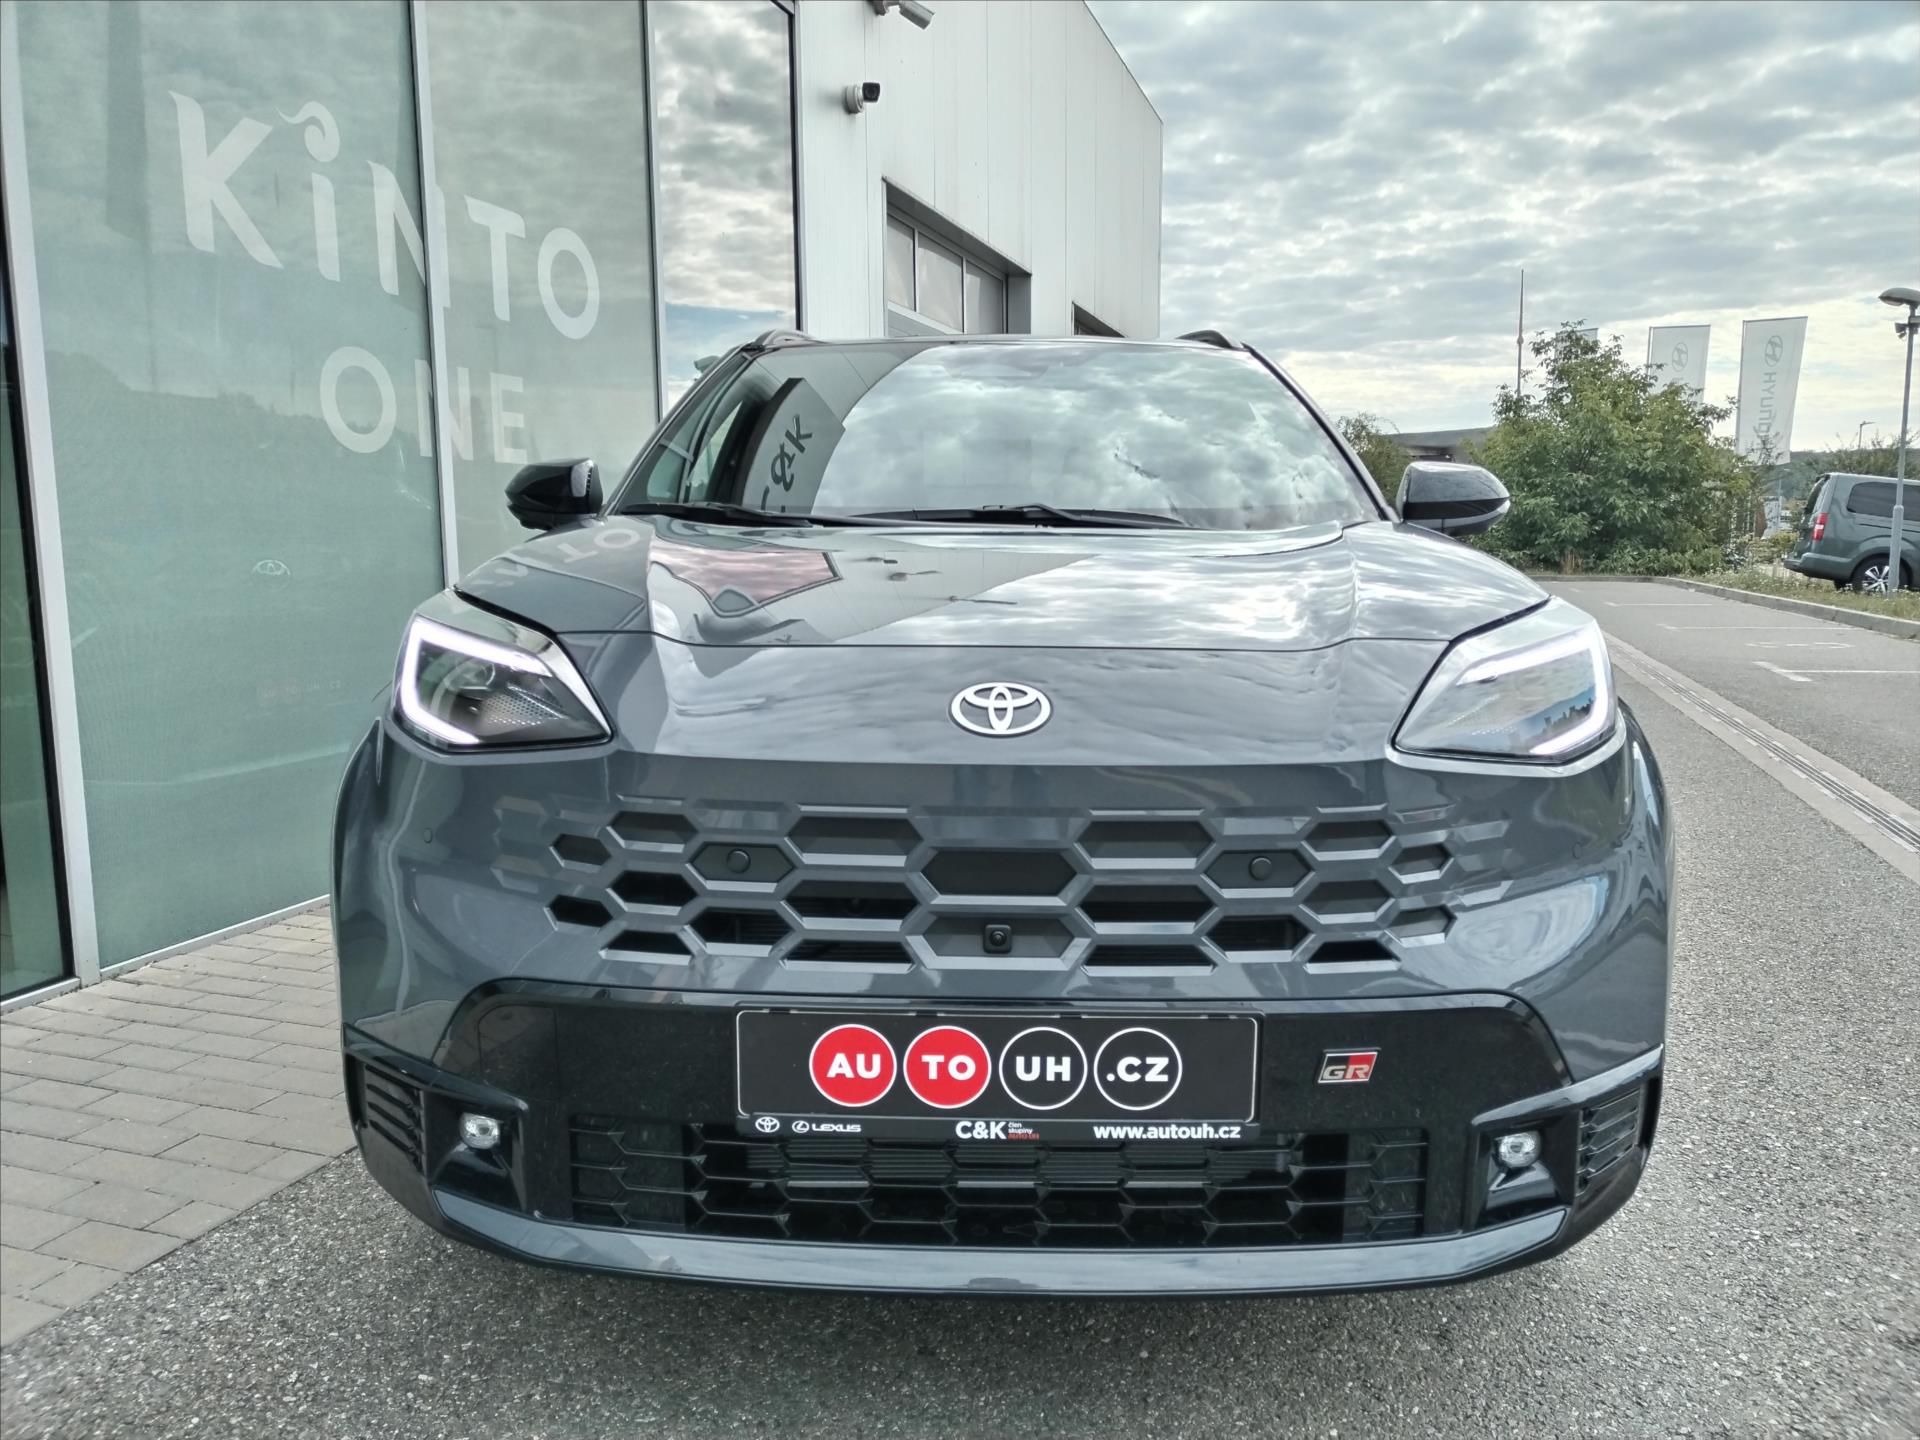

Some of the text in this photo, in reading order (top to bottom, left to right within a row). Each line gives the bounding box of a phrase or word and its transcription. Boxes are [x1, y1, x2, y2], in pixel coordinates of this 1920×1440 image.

[319, 346, 529, 465] ONE
[1758, 371, 1777, 450] HYUND
[1015, 1056, 1071, 1082] UH
[1322, 1064, 1370, 1080] GR
[811, 1123, 862, 1133] LEXUS
[955, 1120, 1008, 1140] C&K
[1093, 1123, 1241, 1139] www.autouh.cz
